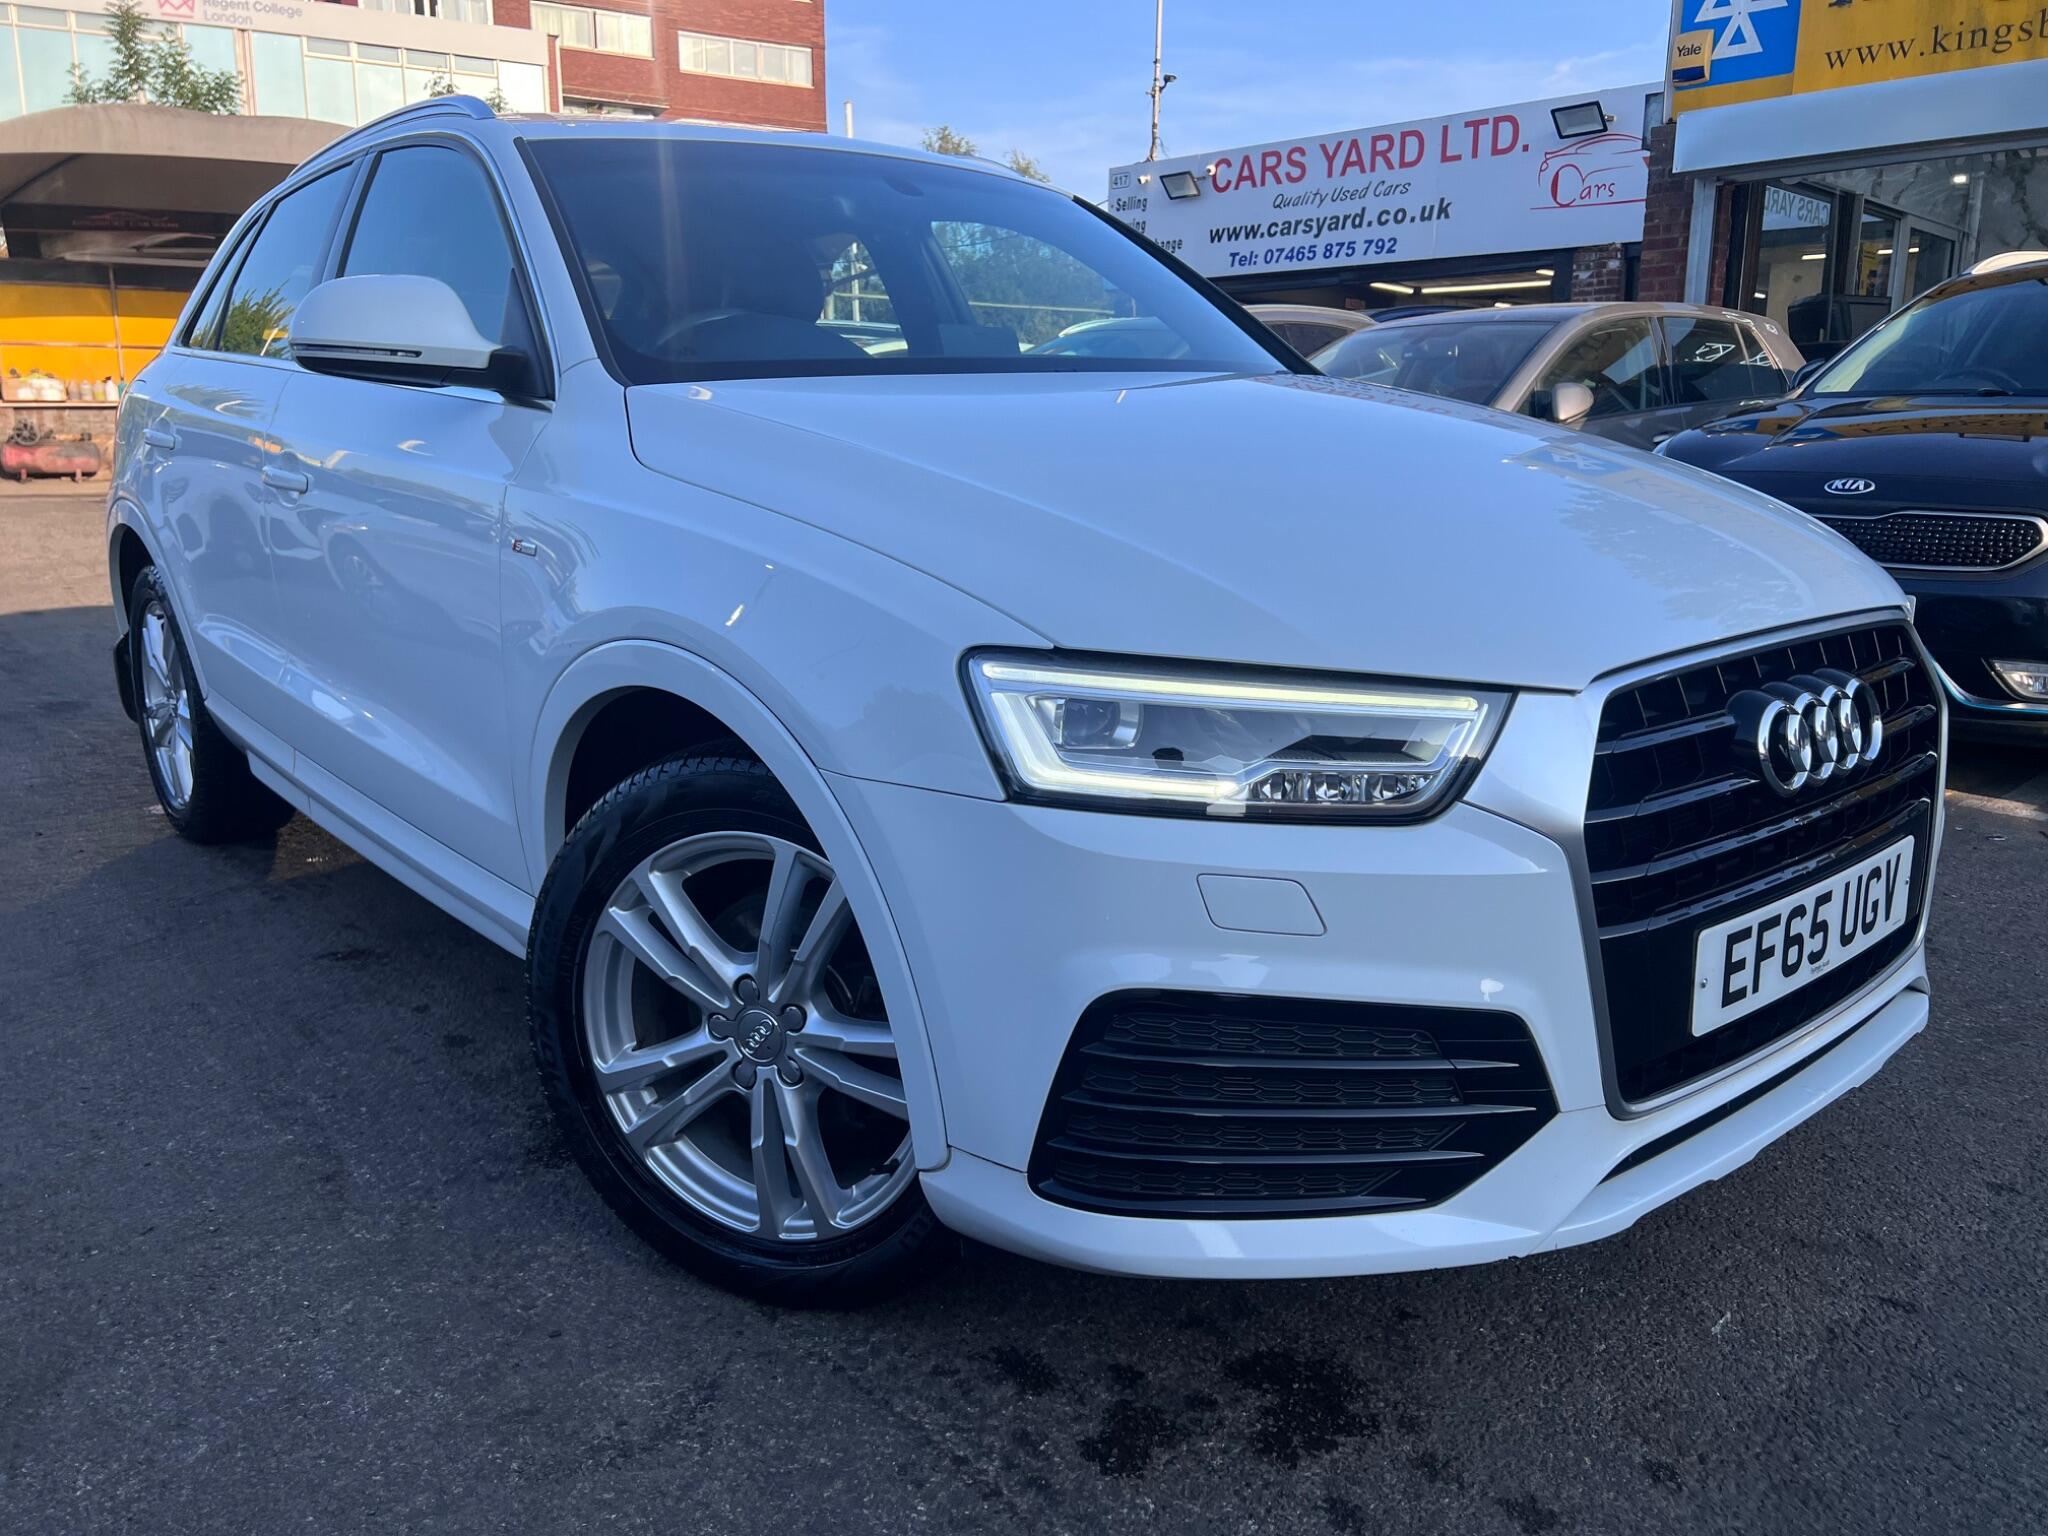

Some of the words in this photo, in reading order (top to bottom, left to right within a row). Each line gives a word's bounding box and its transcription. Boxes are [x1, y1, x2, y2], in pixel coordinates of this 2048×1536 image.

[203, 0, 250, 12] Regent
[253, 1, 304, 18] College
[204, 10, 253, 25] London
[1677, 44, 1702, 57] Yale
[1212, 146, 1307, 193] CARS
[1319, 130, 1425, 178] YARD
[1440, 114, 1530, 163] LTD.
[1112, 174, 1129, 186] 417
[1273, 188, 1328, 209] Quality
[1330, 180, 1371, 202] Used
[1373, 180, 1412, 197] Cars
[1115, 196, 1148, 212] Selling
[1209, 197, 1453, 244] www.carsyard.co.uk
[1229, 252, 1258, 267] Tel:
[1264, 245, 1317, 264] 07465
[1323, 241, 1357, 259] 875
[1363, 237, 1398, 256] 792
[1832, 479, 1865, 490] KIA
[1721, 890, 1833, 1008] EF65
[1840, 852, 1902, 947] UGV
